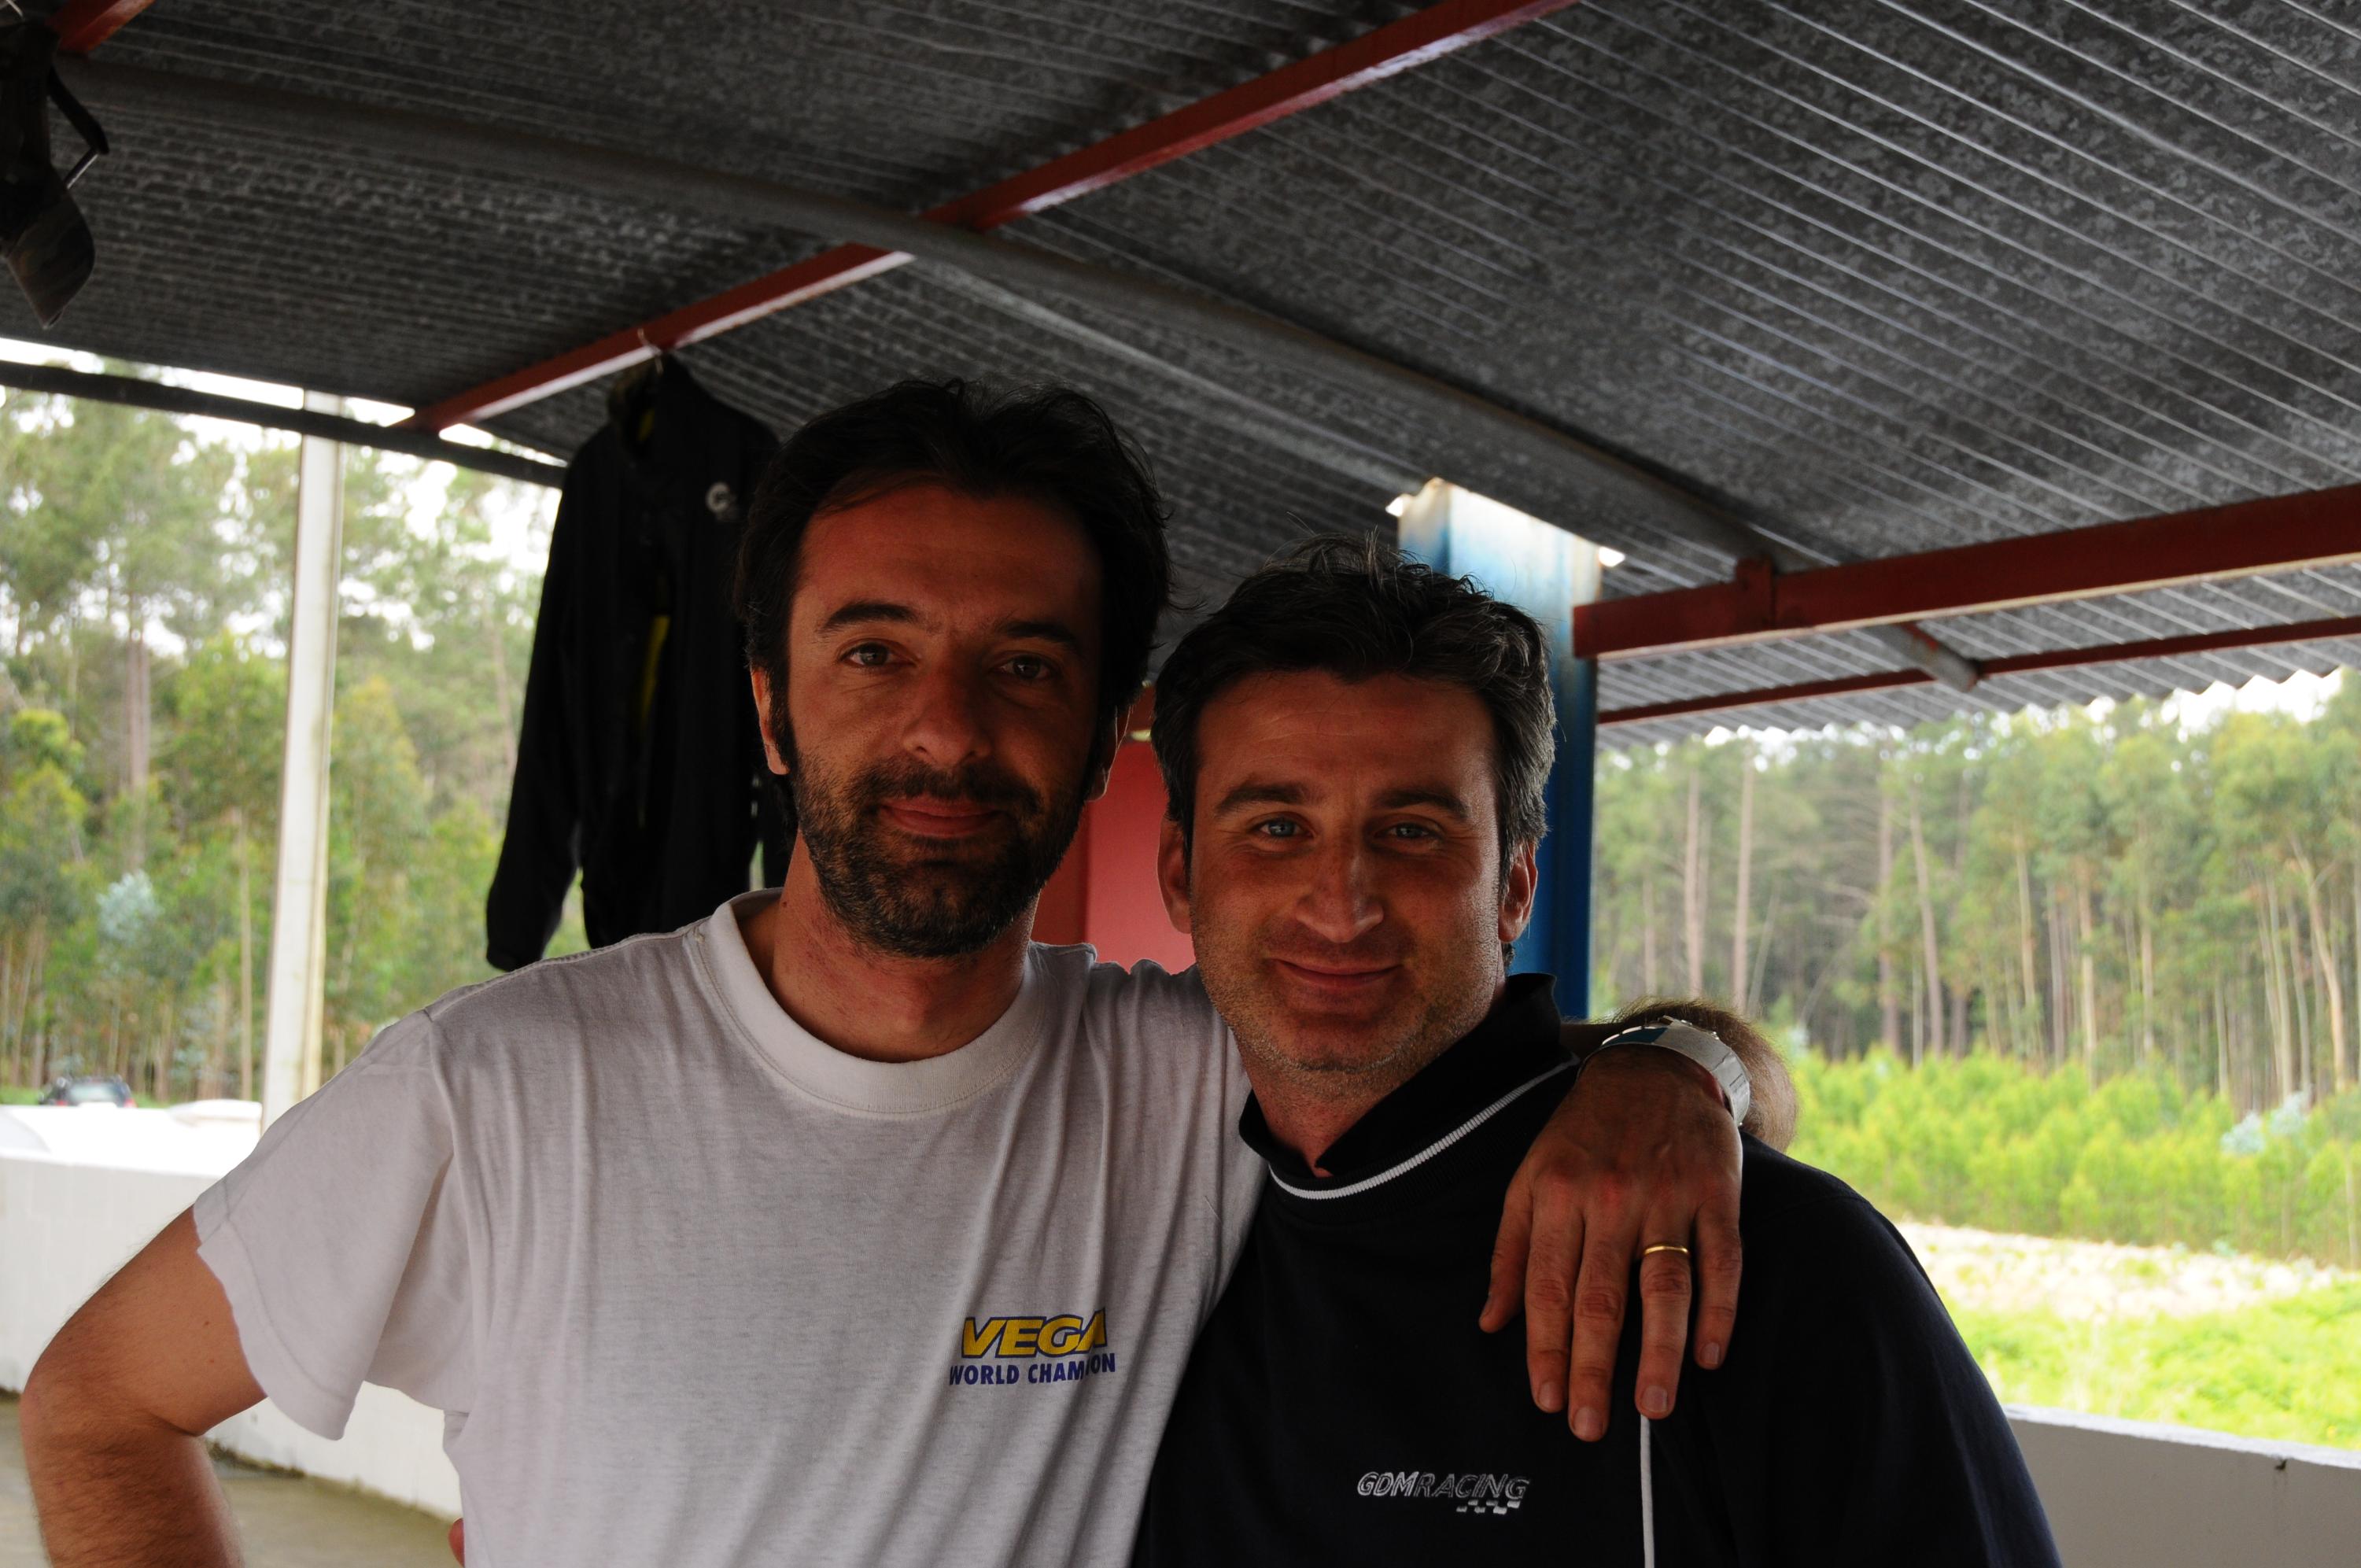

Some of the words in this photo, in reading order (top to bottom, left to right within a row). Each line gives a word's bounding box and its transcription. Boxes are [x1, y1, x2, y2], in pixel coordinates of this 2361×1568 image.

[961, 1308, 1108, 1359] VEGA
[949, 1364, 1020, 1385] WORLD
[1027, 1352, 1116, 1383] CHAMION
